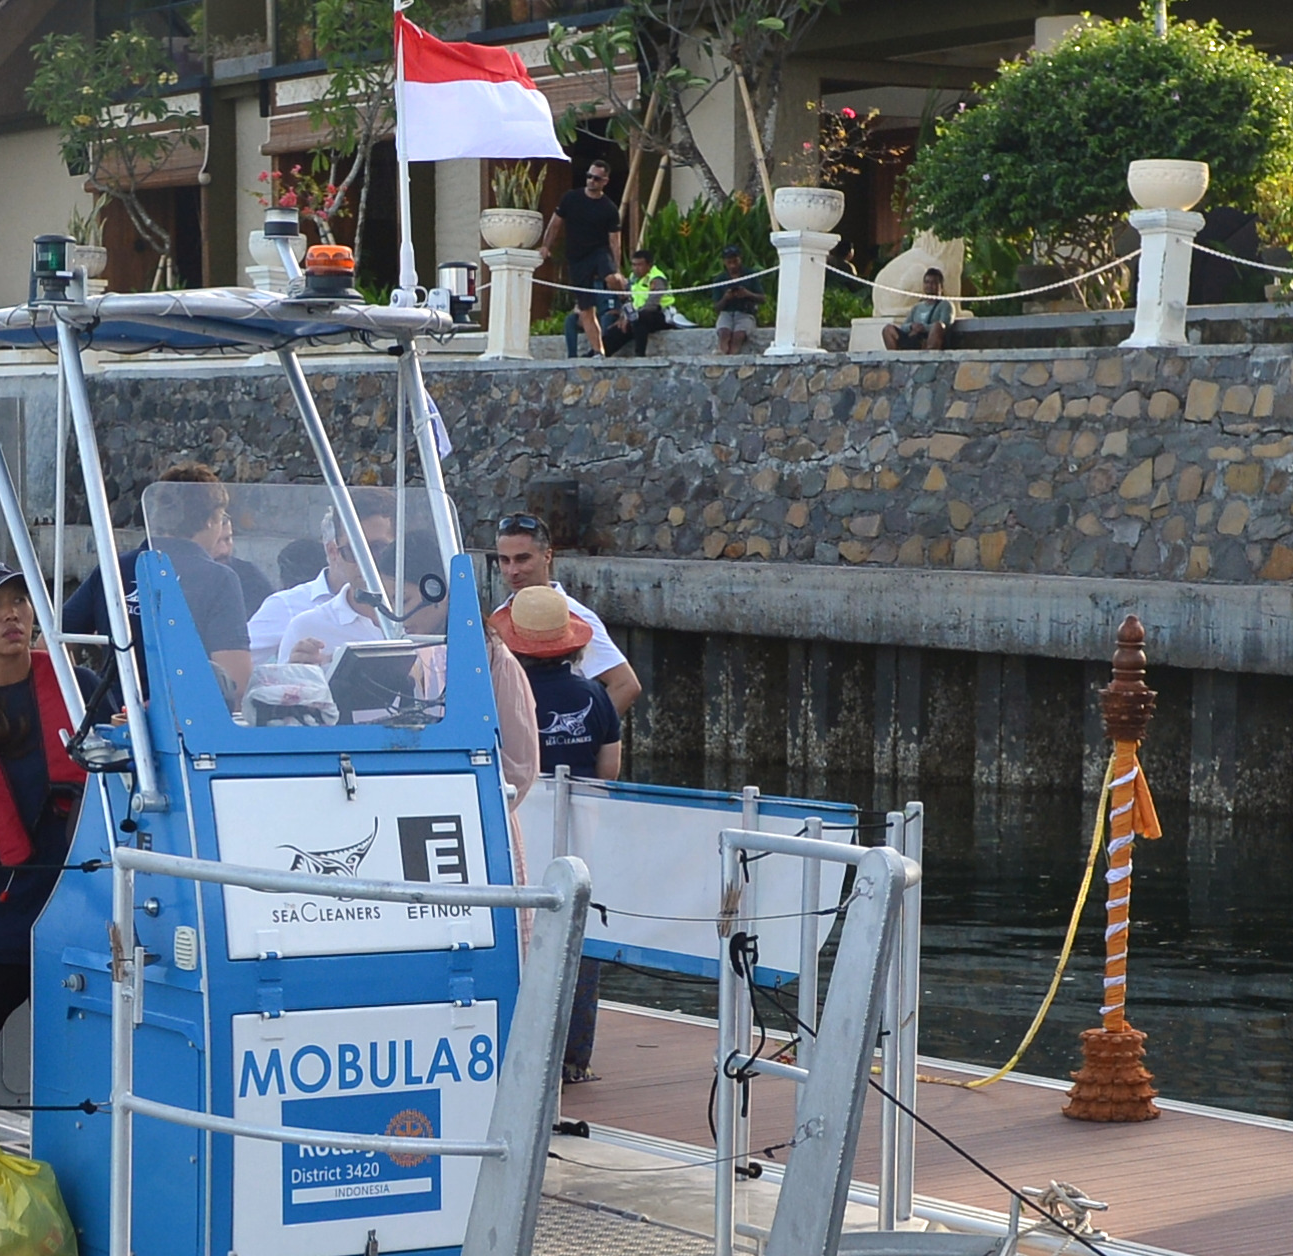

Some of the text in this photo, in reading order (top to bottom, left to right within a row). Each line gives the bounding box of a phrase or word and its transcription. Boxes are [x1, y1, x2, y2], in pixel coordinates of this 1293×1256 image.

[406, 904, 472, 920] EFINOR
[291, 1161, 380, 1184] District 3420
[334, 1183, 390, 1198] INDONESIA
